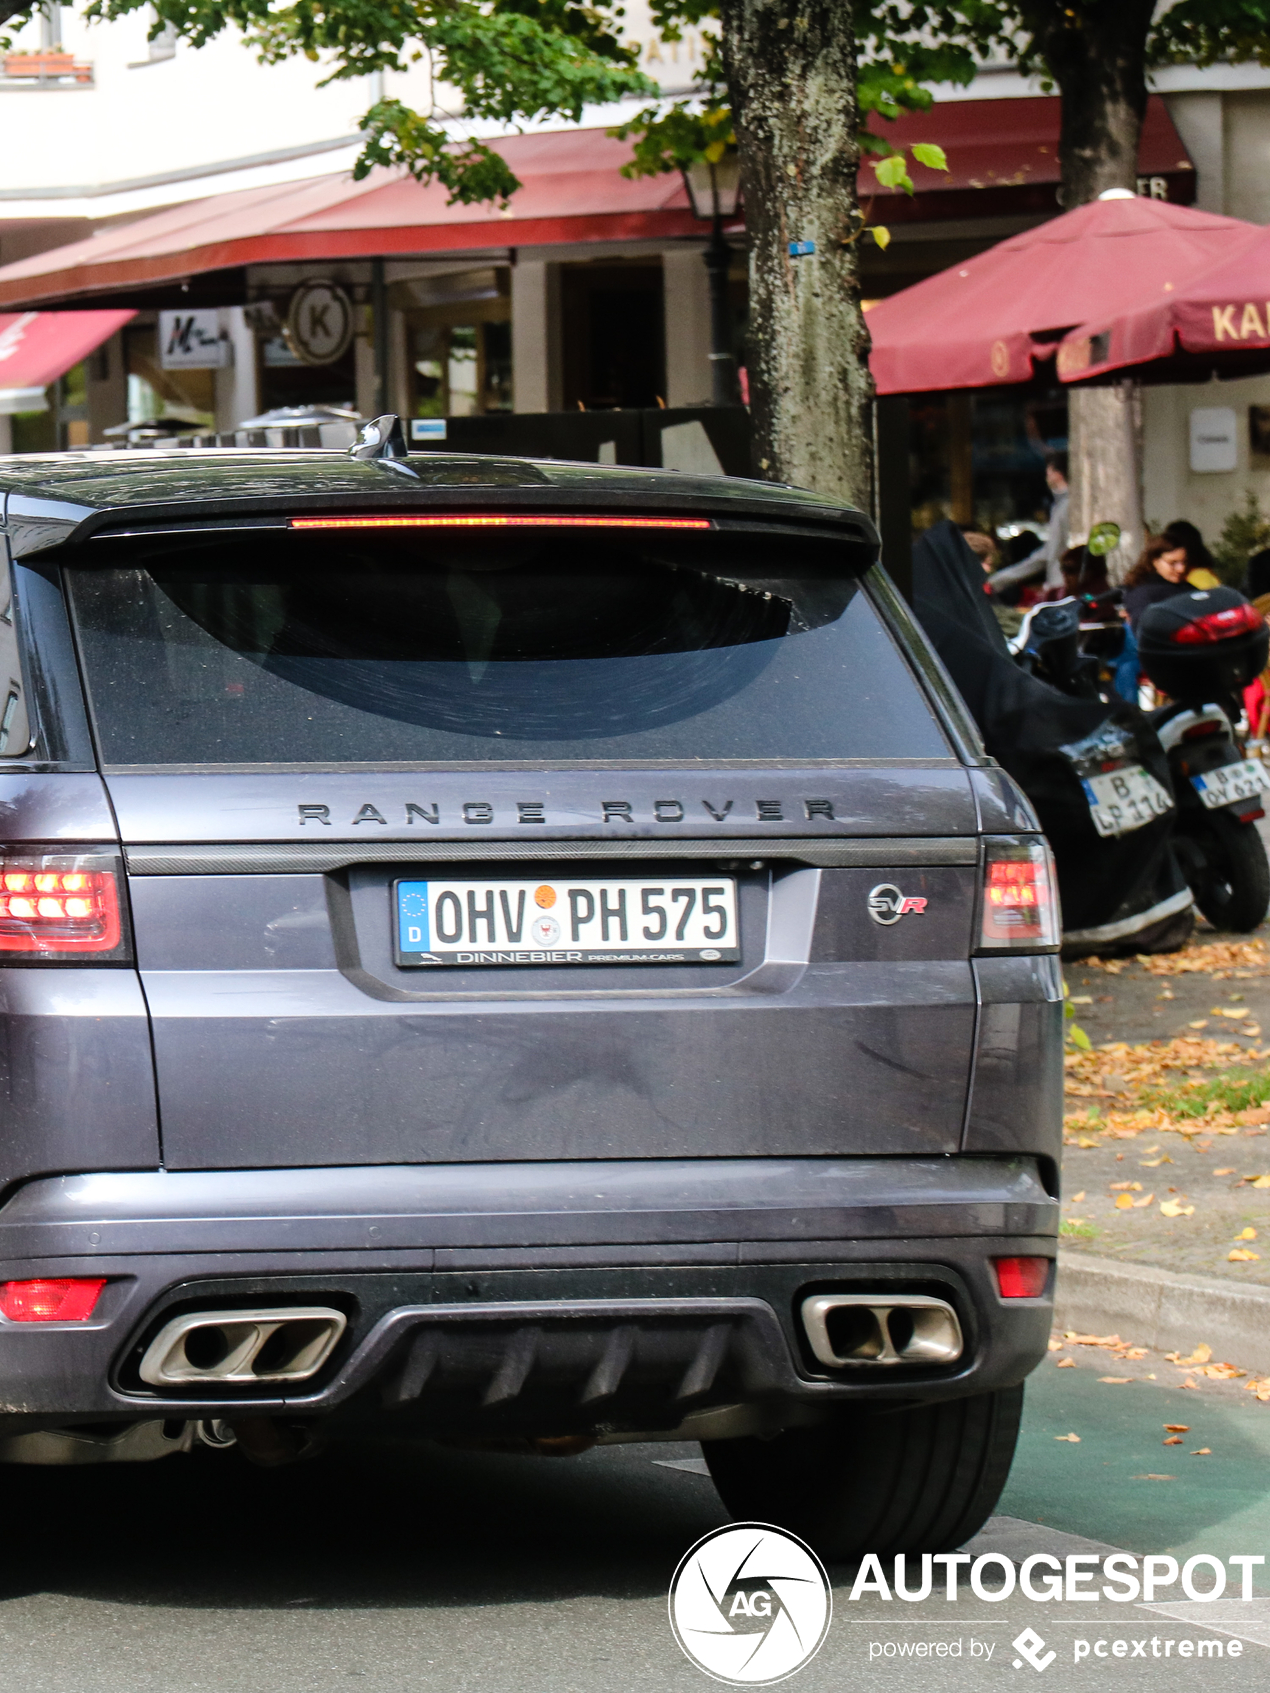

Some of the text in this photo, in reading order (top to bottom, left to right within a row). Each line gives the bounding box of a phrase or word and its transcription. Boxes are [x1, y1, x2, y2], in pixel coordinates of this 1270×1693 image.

[308, 305, 332, 337] K
[1211, 301, 1270, 342] KA
[1110, 775, 1131, 799] B
[298, 799, 837, 825] RANGE ROVER
[435, 889, 526, 944] OHV
[867, 896, 928, 914] SVR
[408, 926, 422, 943] D
[456, 951, 583, 963] DINNEBIER
